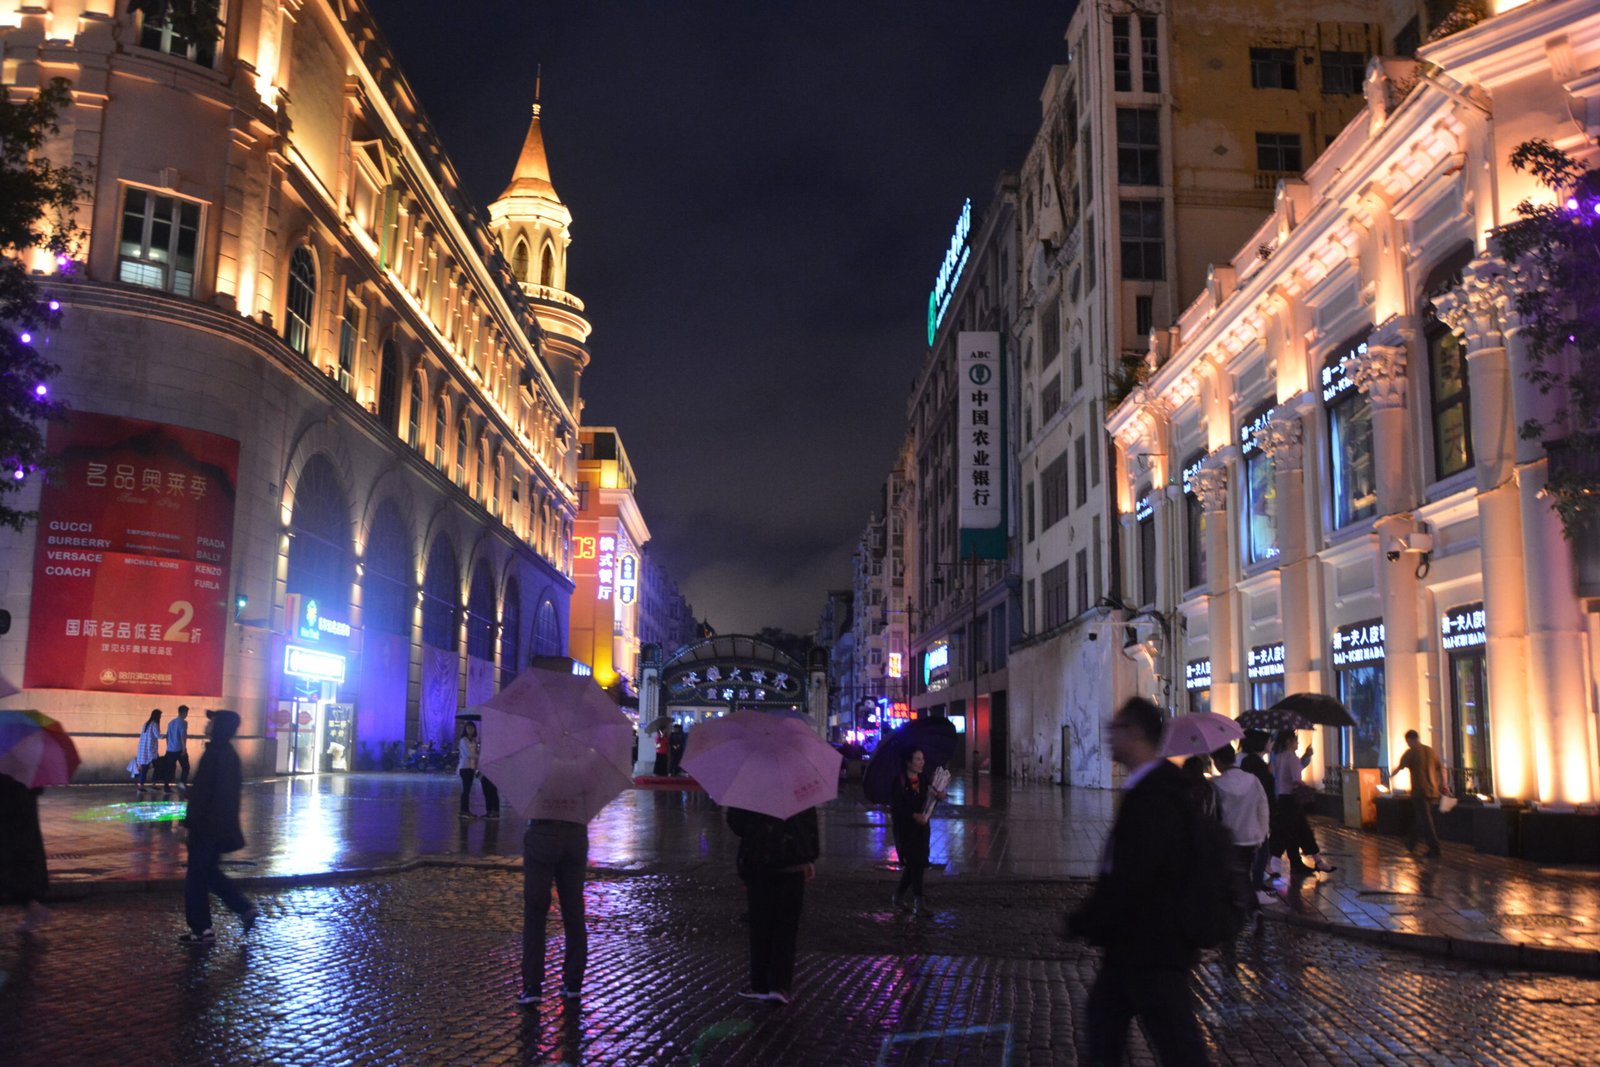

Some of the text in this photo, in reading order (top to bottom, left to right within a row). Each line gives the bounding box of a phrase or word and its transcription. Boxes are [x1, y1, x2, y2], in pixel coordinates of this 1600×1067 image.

[971, 390, 991, 506] 中国农业银行
[87, 461, 208, 500] 名品奥莱季
[49, 520, 92, 533] GUCCI
[47, 536, 112, 548] BURBERRY
[196, 536, 225, 549] PRADA
[47, 551, 103, 563] VERSACE
[196, 550, 222, 562] BALLY
[124, 558, 180, 570] MICHAEL KORS
[45, 566, 91, 577] COACH
[194, 565, 222, 576] KENZO
[194, 579, 220, 590] FURLA
